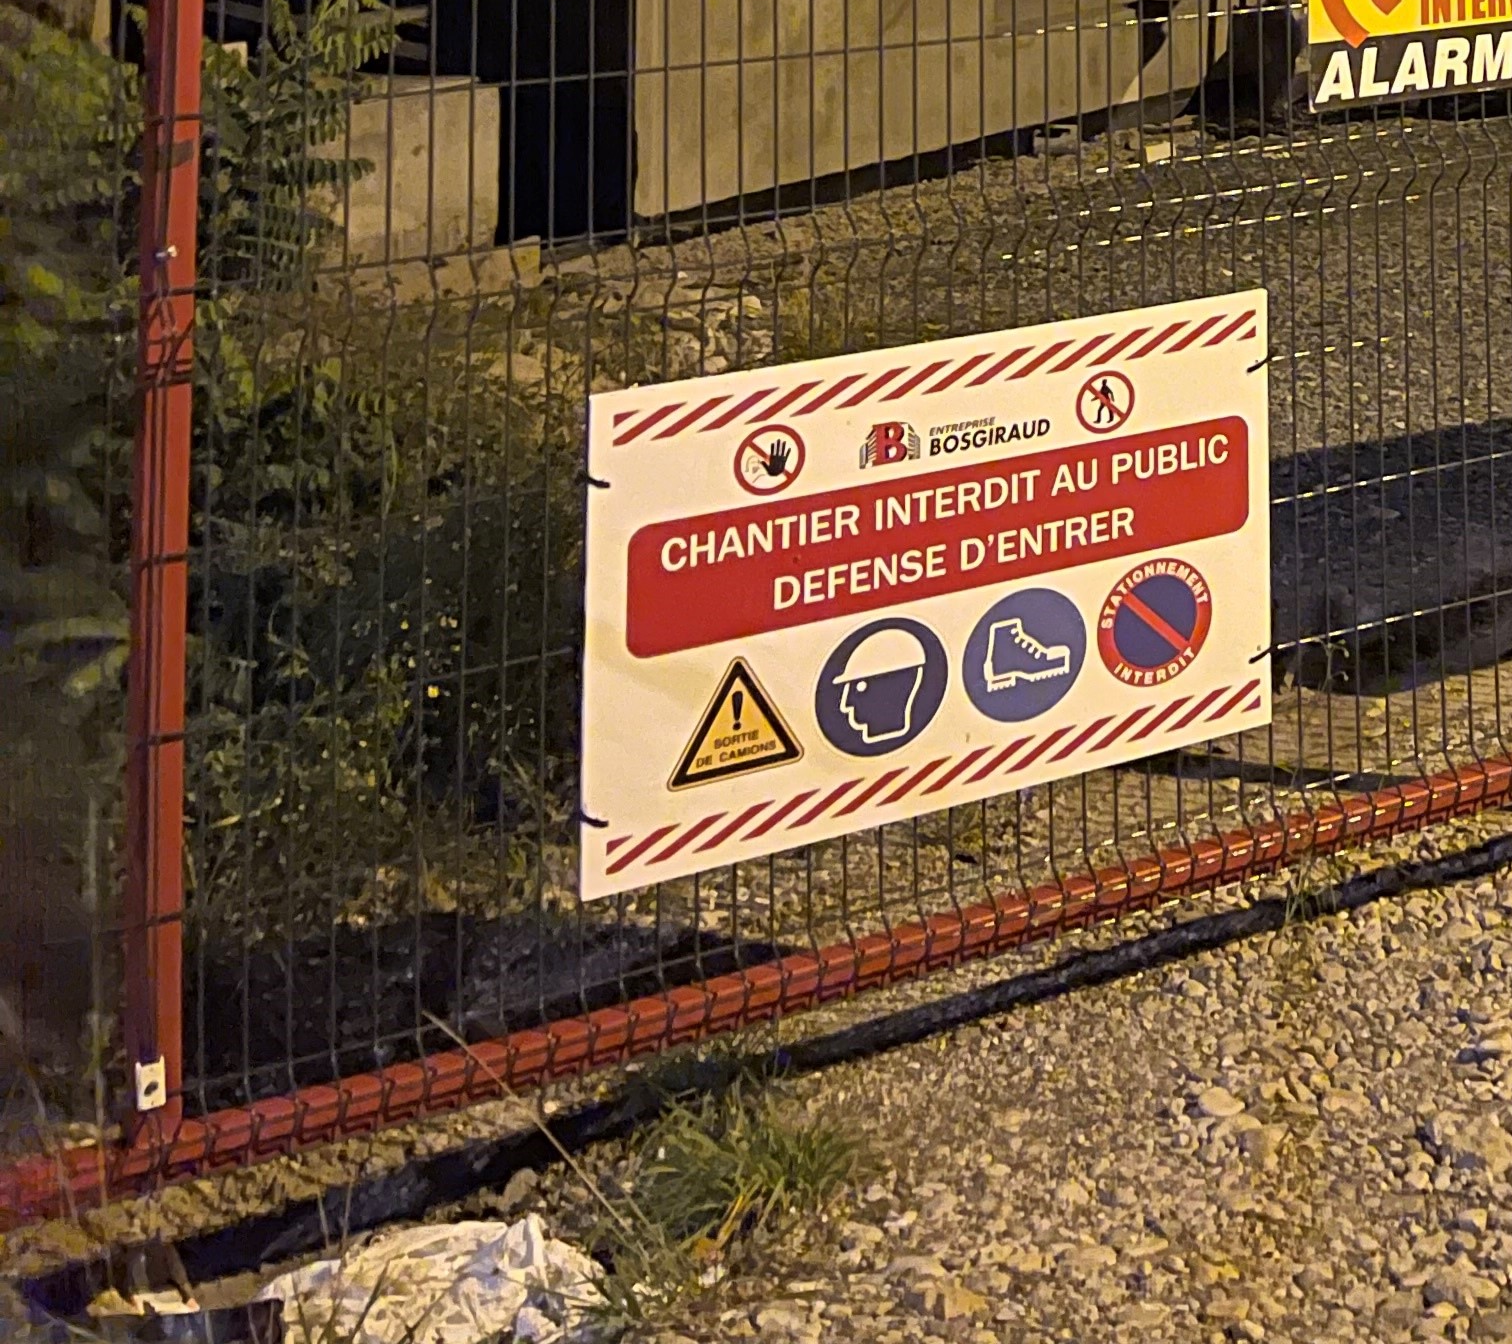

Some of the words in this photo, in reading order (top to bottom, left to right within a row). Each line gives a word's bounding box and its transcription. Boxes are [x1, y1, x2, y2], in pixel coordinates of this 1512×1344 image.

[928, 416, 996, 437] ENTREPRISE
[929, 418, 1051, 457] BOSGIRAUD
[660, 504, 861, 574] CHANTIER
[874, 469, 1042, 531] INTERDIT
[1050, 460, 1099, 497] AU
[1111, 433, 1230, 485] PUBLIC
[772, 542, 947, 611] DEFENSE
[959, 506, 1136, 571] D'ENTRER
[1100, 561, 1209, 630] STATIONNEMENT
[1113, 646, 1195, 685] INTERDIT
[696, 755, 713, 768] DE
[719, 740, 776, 762] CAMIONS
[714, 730, 759, 749] SORTIE
